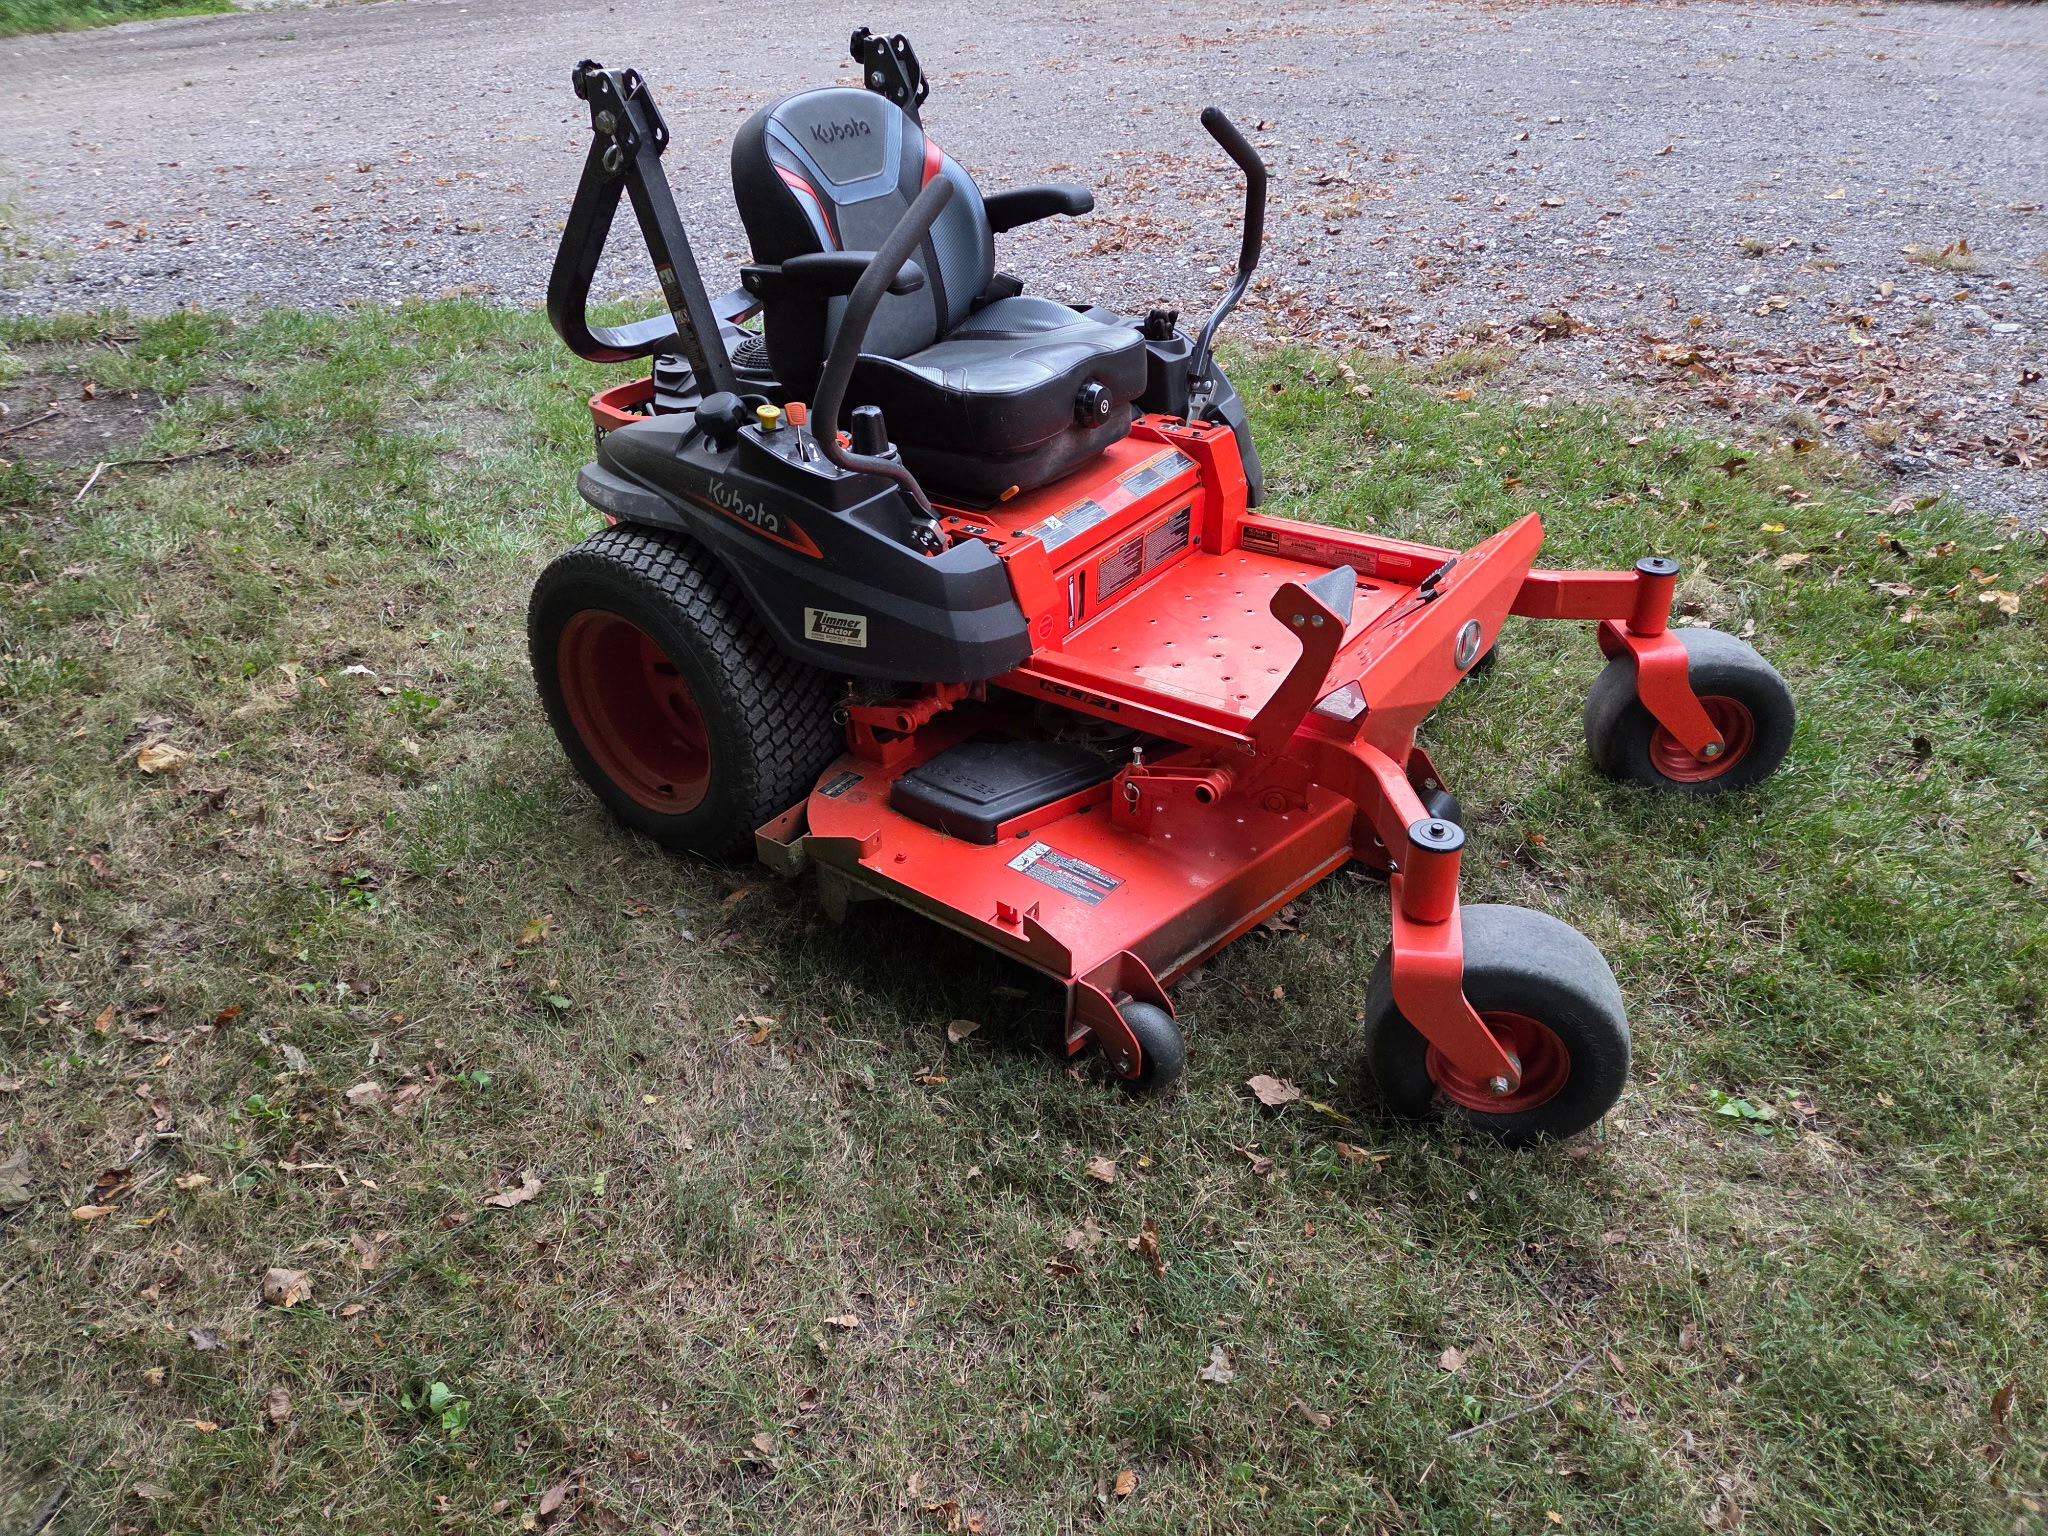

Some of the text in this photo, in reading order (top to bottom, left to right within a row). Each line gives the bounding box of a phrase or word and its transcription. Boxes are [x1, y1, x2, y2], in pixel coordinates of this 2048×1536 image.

[810, 118, 871, 143] Kubota
[709, 477, 778, 533] Kubota
[821, 624, 853, 636] Tractor
[1043, 681, 1114, 710] K-LIFT
